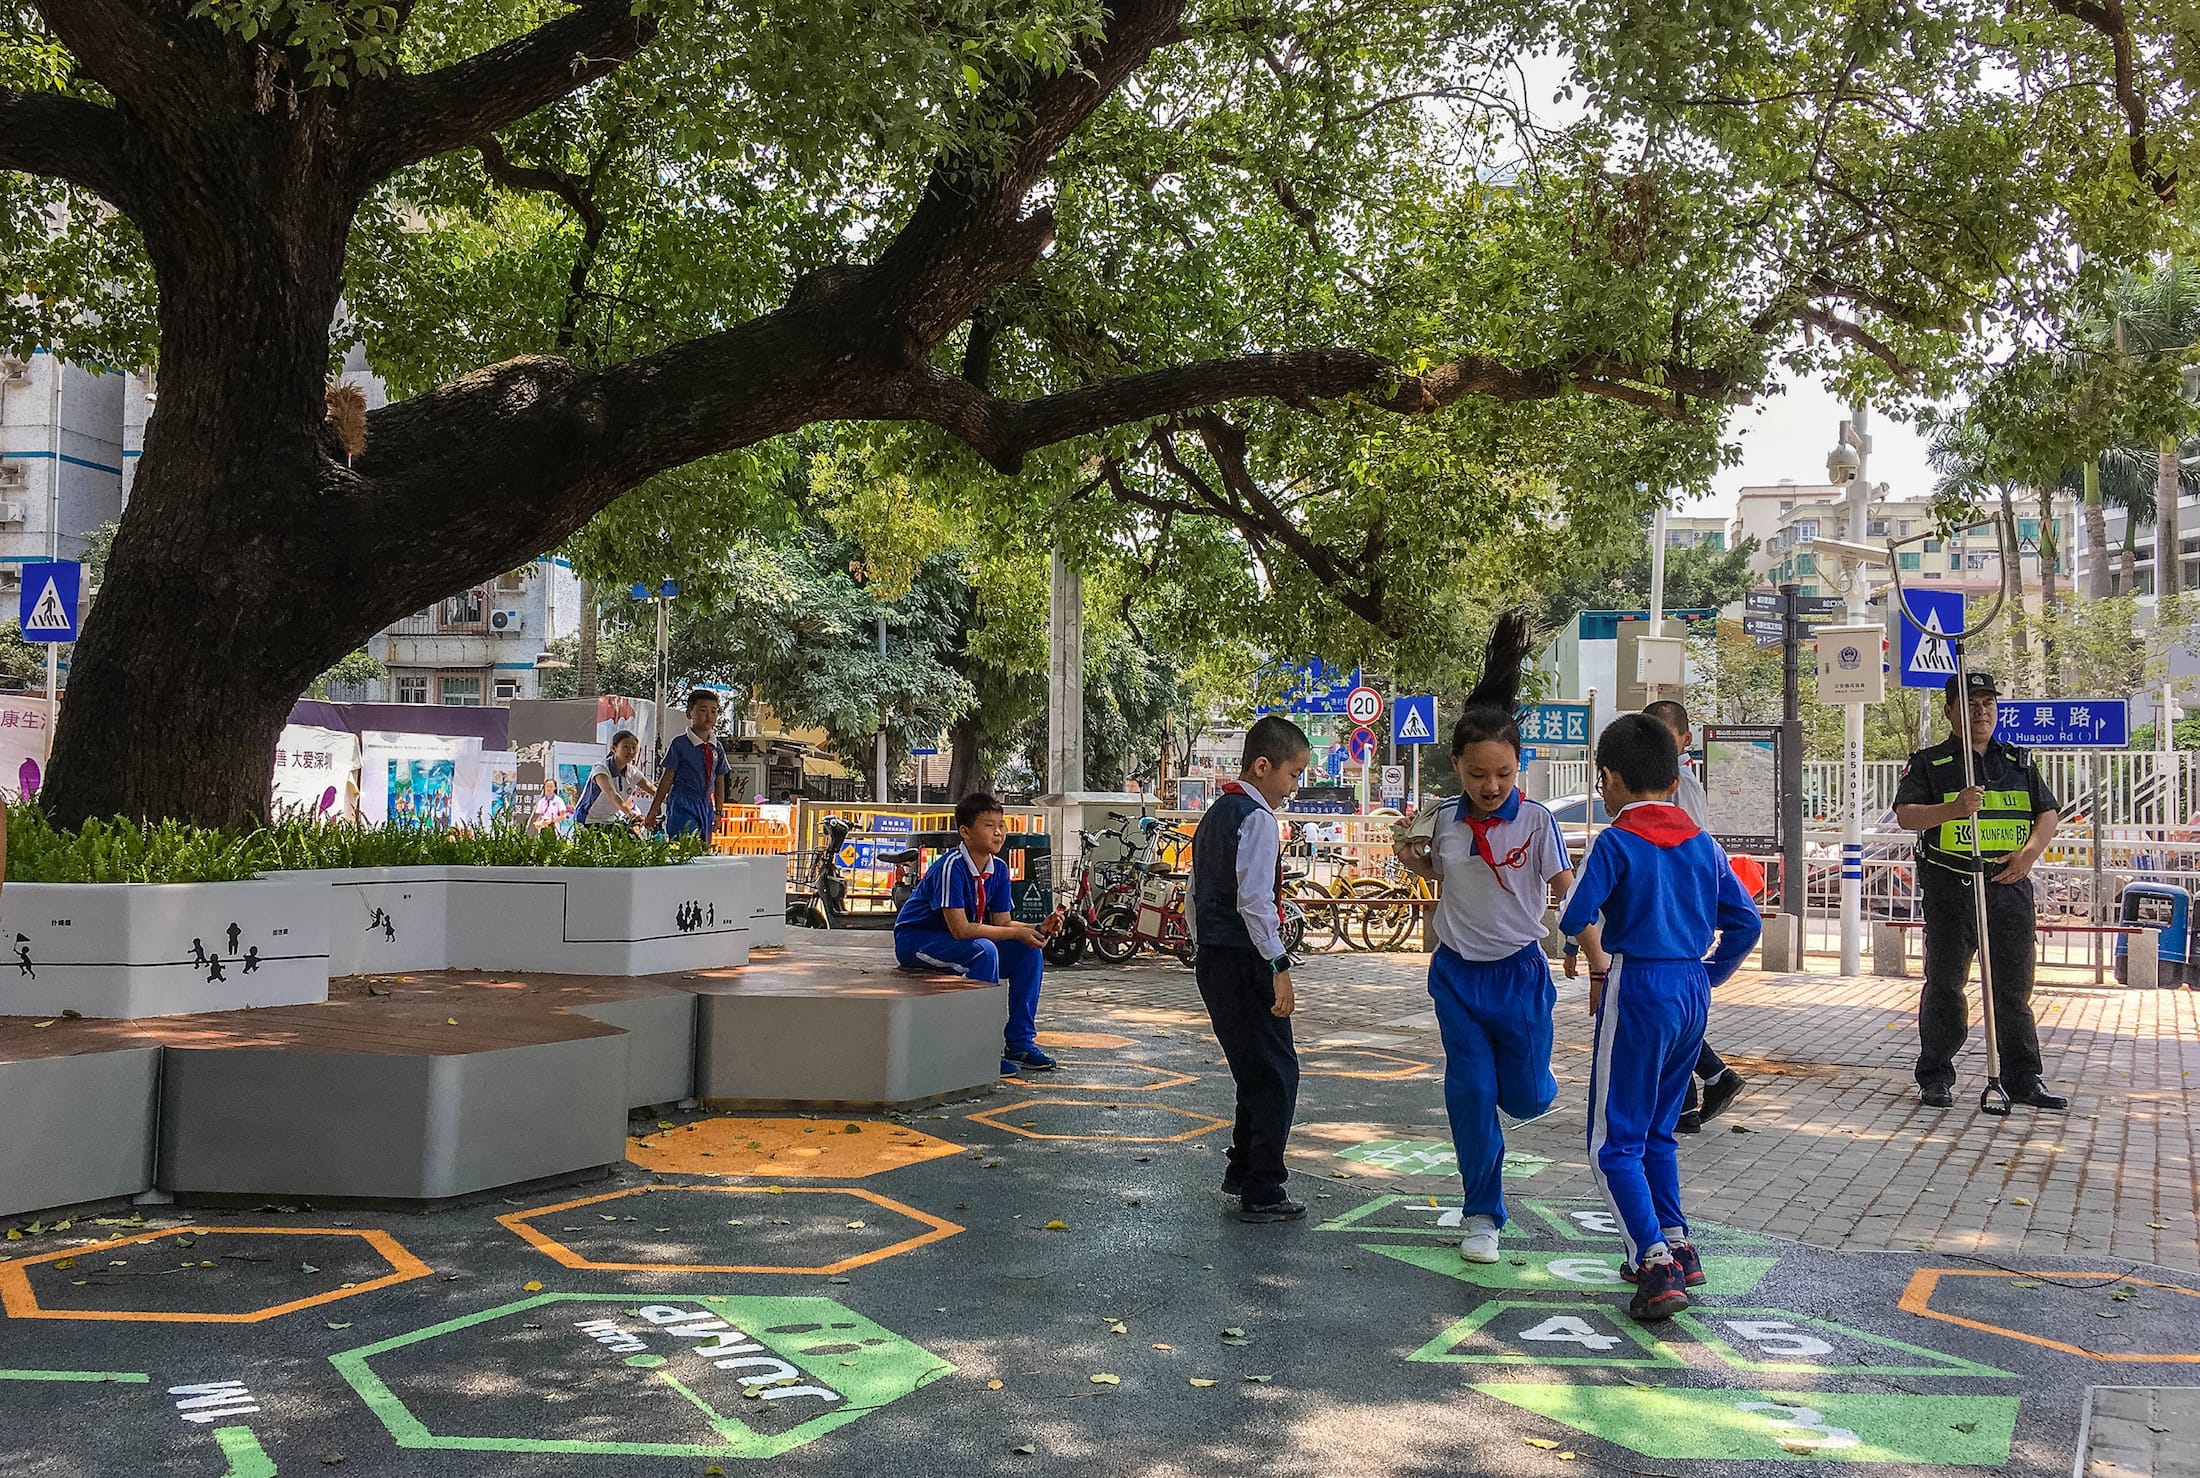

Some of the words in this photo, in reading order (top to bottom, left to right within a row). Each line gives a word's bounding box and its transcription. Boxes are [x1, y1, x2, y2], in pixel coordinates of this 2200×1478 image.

[1354, 697, 1374, 714] 20
[1999, 706, 2091, 728] 花果路
[1519, 710, 1584, 740] 接送区
[2016, 733, 2054, 743] Huaguo
[2060, 732, 2073, 741] Rd
[1849, 741, 1857, 819] 05540194
[1981, 828, 2014, 841] XUNFANG
[2016, 825, 2028, 846] 防
[1547, 1258, 1624, 1284] 6
[1518, 1315, 1623, 1350] 4
[1724, 1321, 1834, 1355] 5
[640, 1305, 840, 1401] JUMP
[1735, 1402, 1862, 1449] 3
